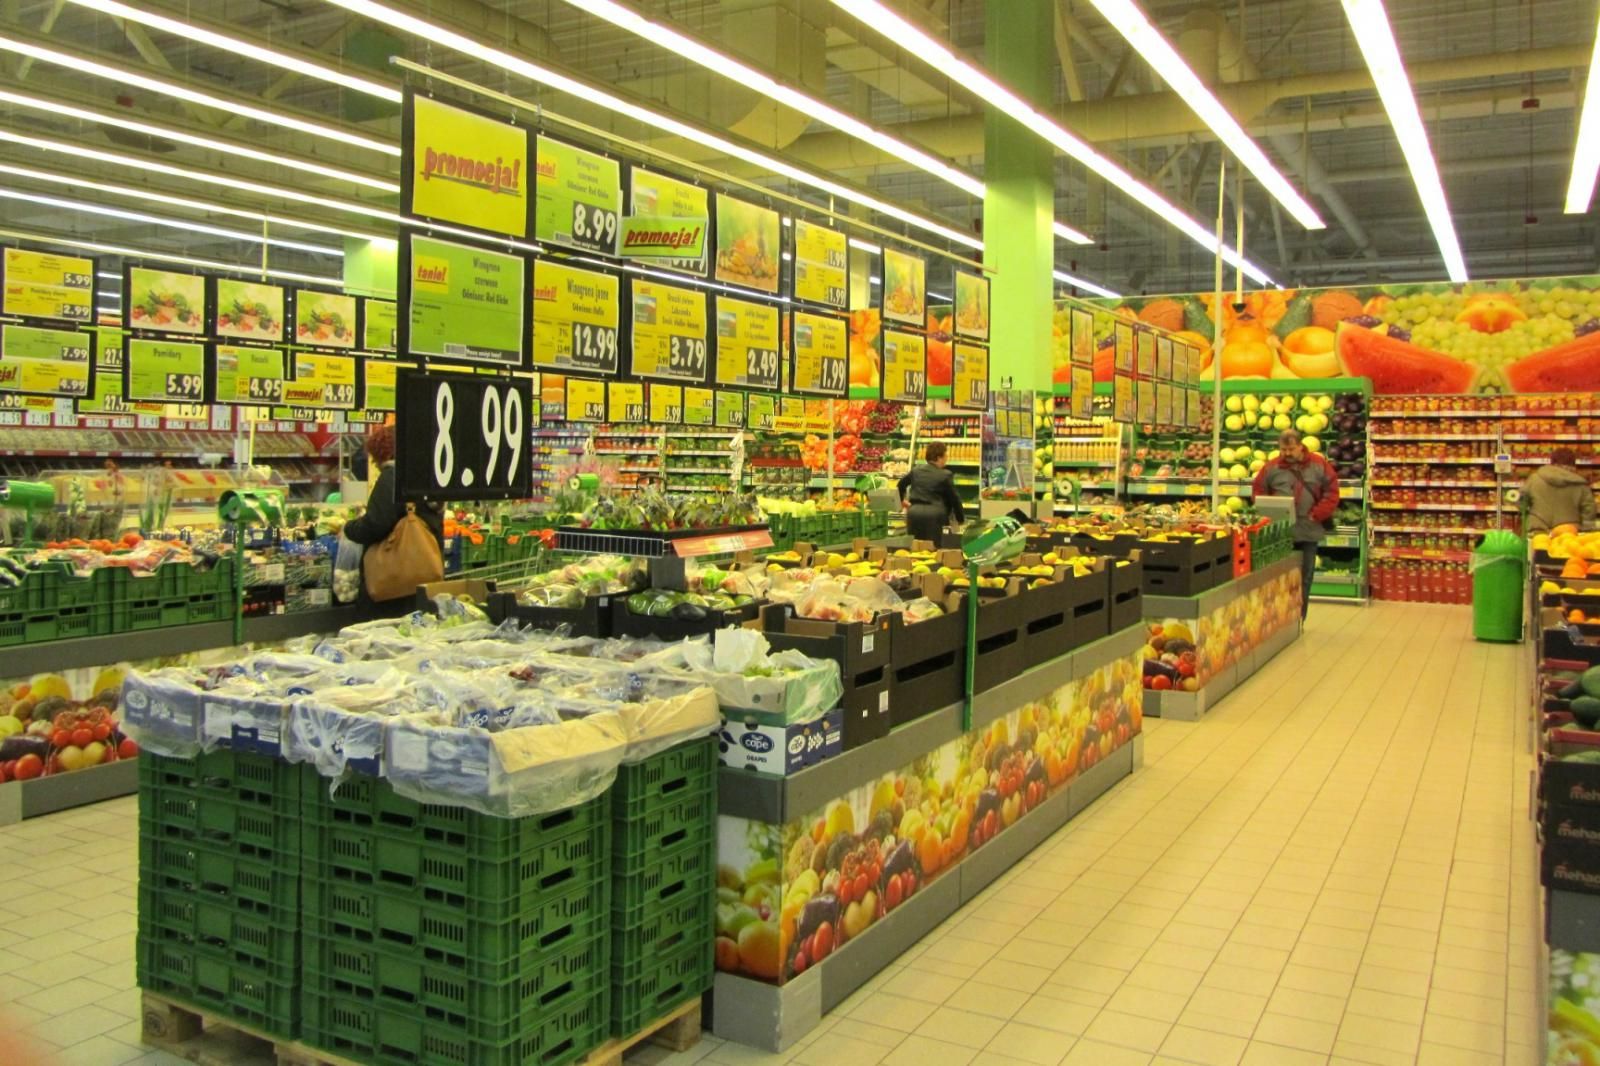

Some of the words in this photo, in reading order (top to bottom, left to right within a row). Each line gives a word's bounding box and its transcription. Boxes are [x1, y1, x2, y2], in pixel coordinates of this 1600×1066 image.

[424, 147, 520, 194] promocja!
[574, 203, 616, 245] 8.99
[624, 227, 700, 249] promocja!
[64, 273, 90, 286] 5.99
[63, 305, 89, 317] 2.99
[574, 323, 615, 361] 12.99
[671, 336, 705, 369] 3.79
[748, 349, 777, 378] 2.49
[822, 356, 845, 389] 1.99
[167, 374, 202, 395] 5.99
[250, 377, 282, 398] 4.95
[905, 371, 924, 393] 1.99
[285, 388, 323, 402] promocja!
[325, 384, 353, 402] 4.49
[585, 402, 604, 418] 8.99
[626, 404, 643, 420] 1.49
[434, 381, 523, 488] 8.99
[745, 738, 769, 751] cape
